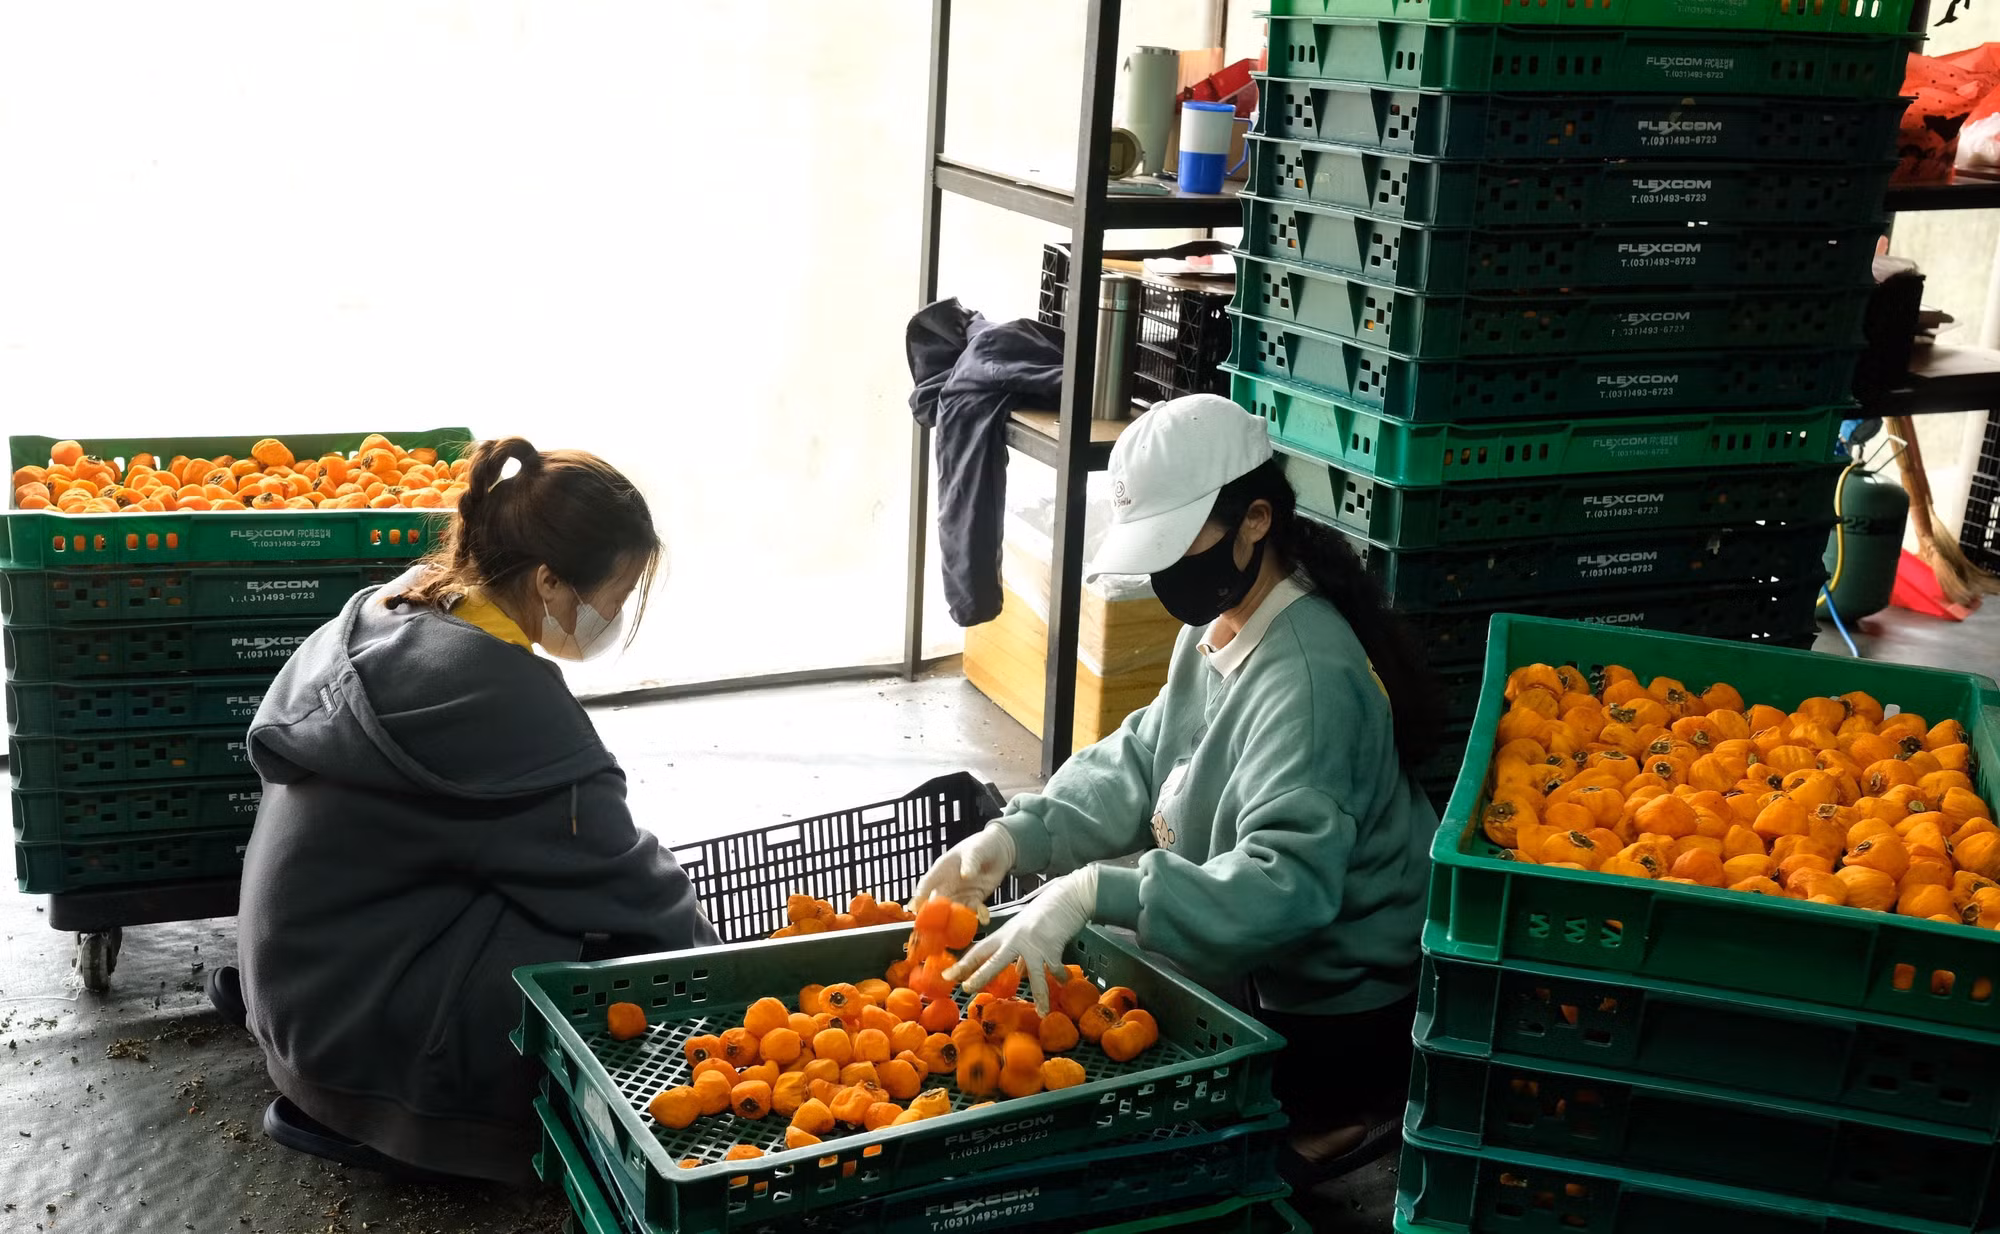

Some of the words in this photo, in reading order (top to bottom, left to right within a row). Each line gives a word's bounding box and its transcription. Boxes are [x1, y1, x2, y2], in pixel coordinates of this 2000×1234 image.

[1646, 56, 1702, 69] FLEXCOM
[1664, 70, 1724, 79] T.(031)493-6723
[1637, 120, 1722, 135] FLEXCOM
[1640, 136, 1717, 146] T.(031)493-6723
[1631, 193, 1707, 204] T.(031)493-6723
[1618, 243, 1702, 257] FLEXCOM
[1621, 257, 1696, 267] T.(031)493-6723
[1596, 374, 1679, 388] FLEXCOM
[1600, 387, 1674, 399] T.(031)493-6723
[1593, 437, 1648, 450] FLEXCOM
[1582, 493, 1664, 508] FLEXCOM
[1585, 506, 1659, 518] T.(031)493-6723
[230, 529, 295, 541] FLEXCOM
[252, 540, 321, 548] T.(031)493-6723
[1577, 551, 1658, 568] FLEXCOM
[944, 1114, 1054, 1146] FLEXCOM
[949, 1129, 1049, 1160] T.(031)493-6723
[925, 1186, 1040, 1217] FLEXCOM
[930, 1202, 1035, 1233] T.(031)493-6723
